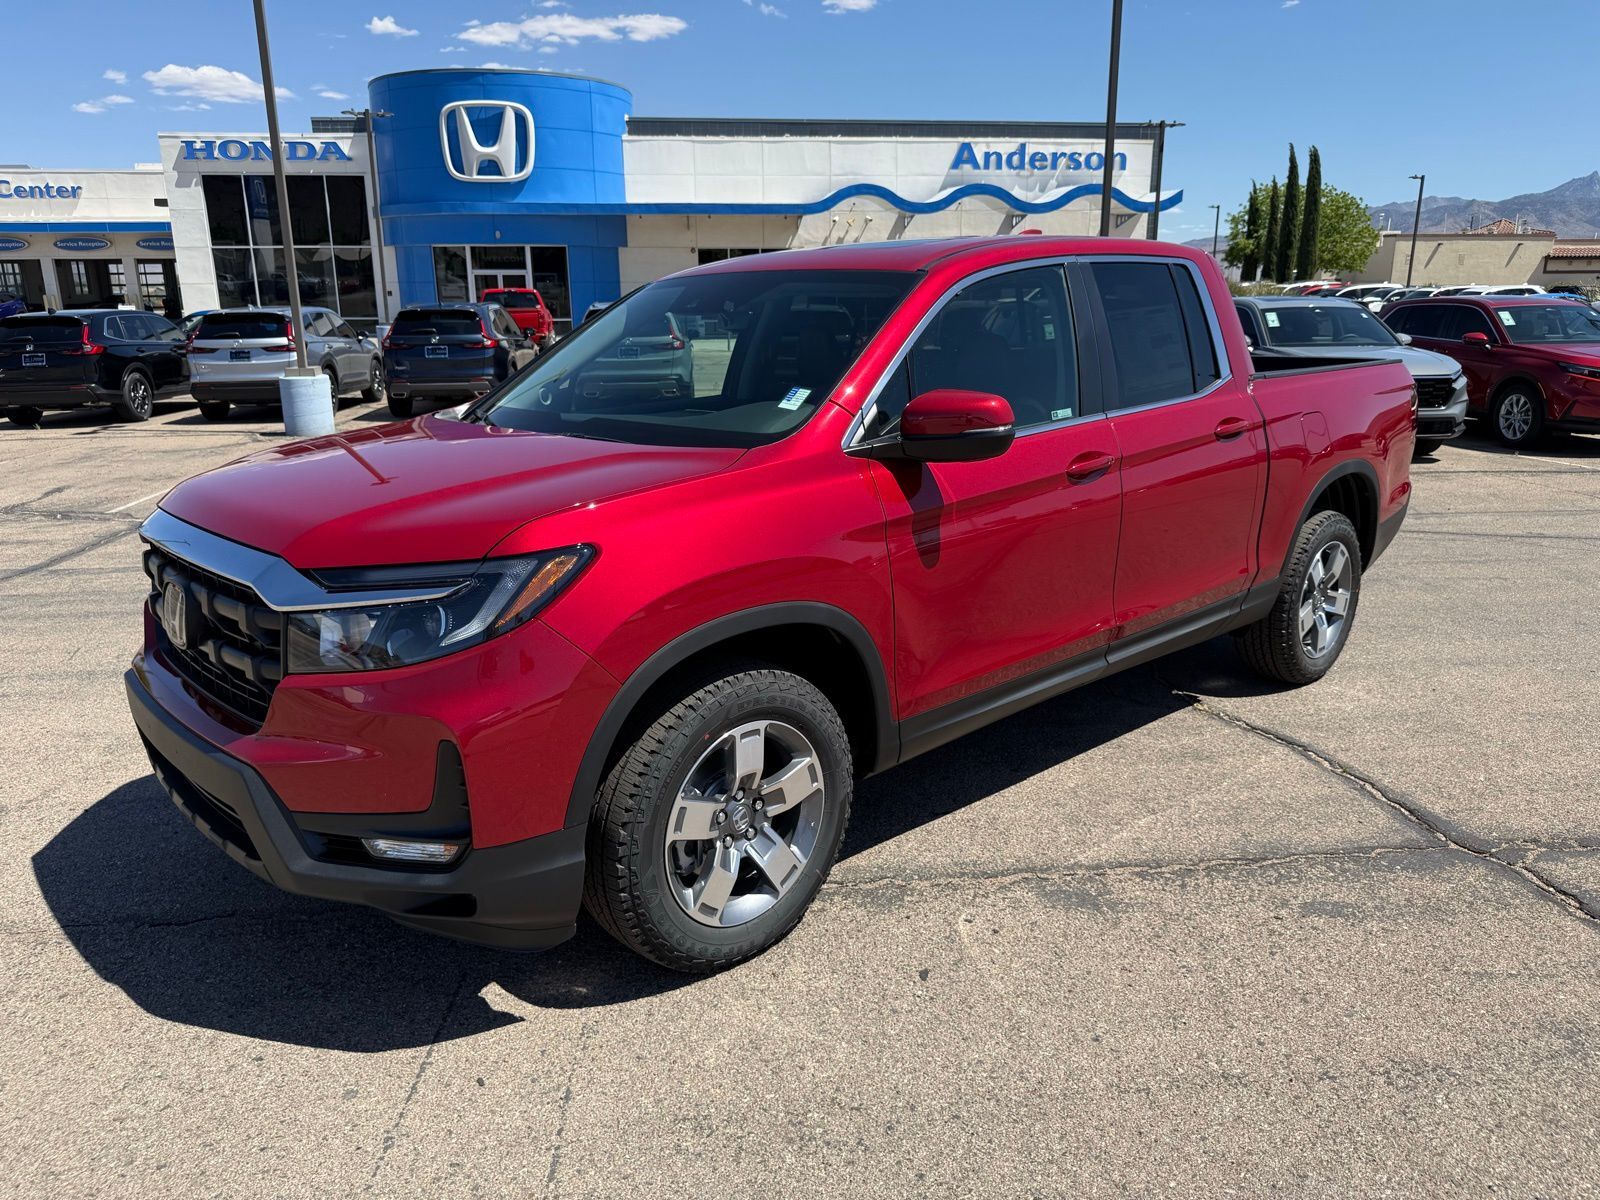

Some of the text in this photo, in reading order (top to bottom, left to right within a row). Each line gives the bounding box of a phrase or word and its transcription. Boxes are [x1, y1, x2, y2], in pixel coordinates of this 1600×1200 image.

[180, 139, 353, 161] HONDA
[951, 142, 1127, 171] Anderson
[0, 180, 82, 198] Center
